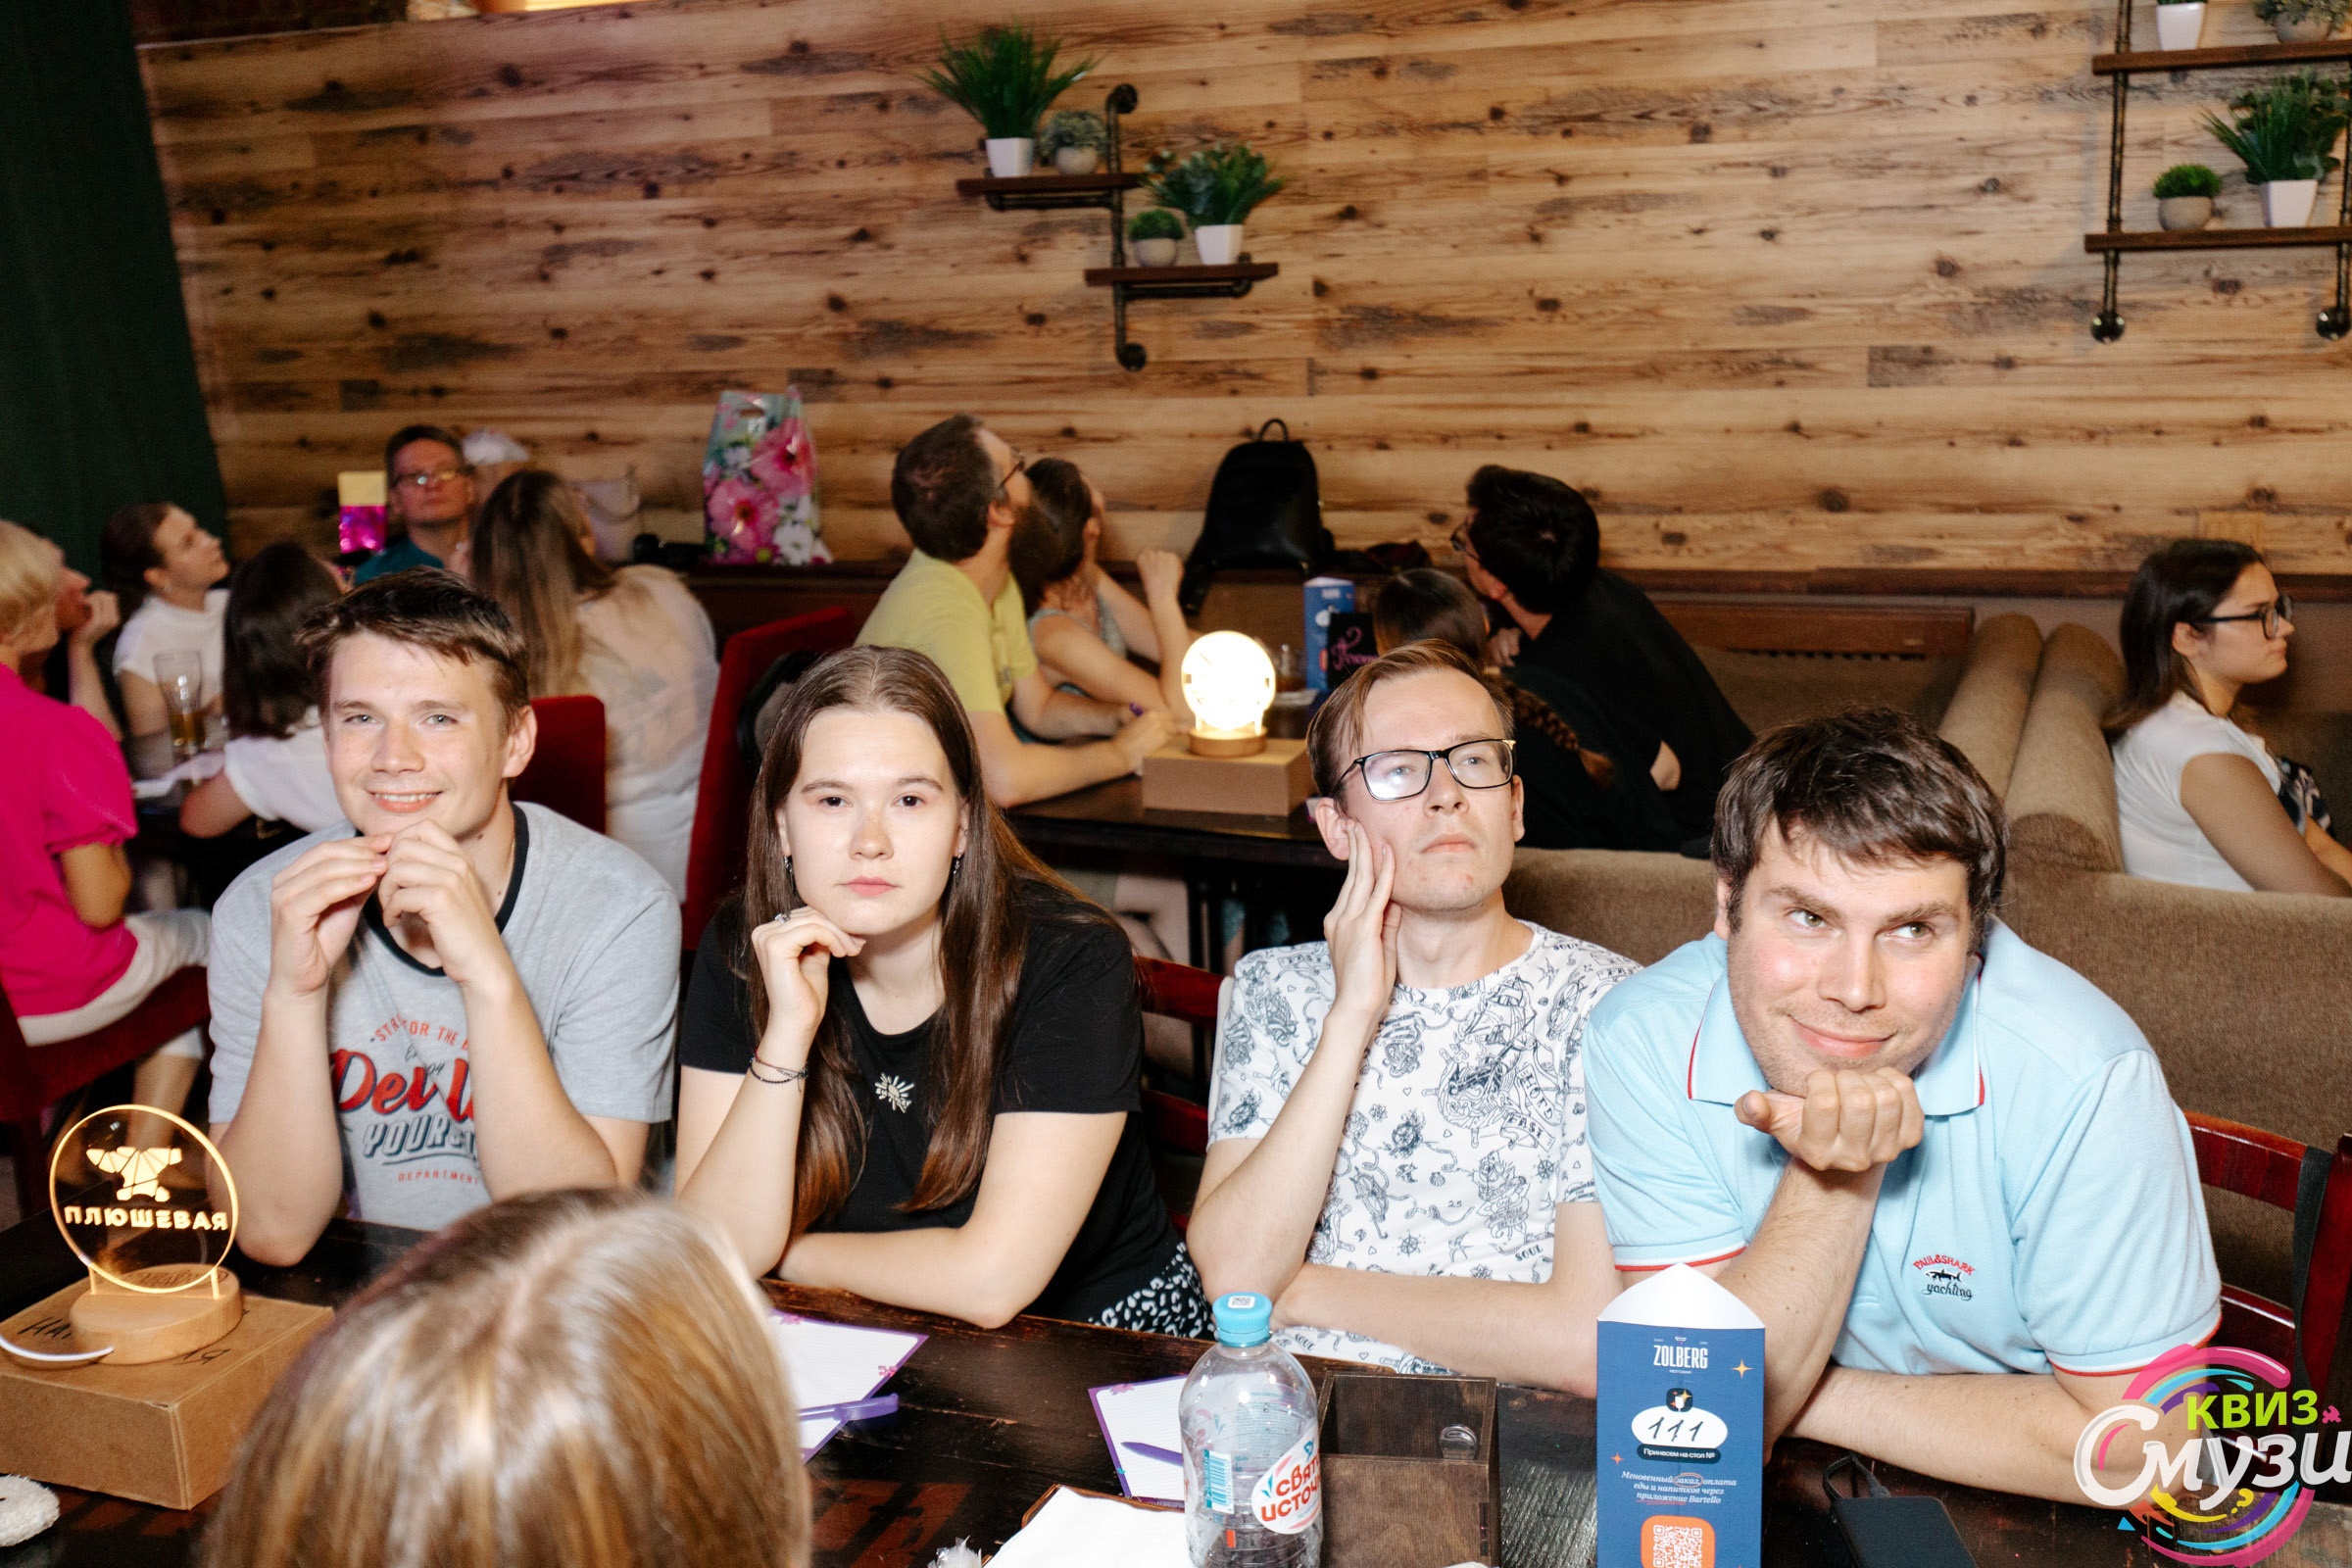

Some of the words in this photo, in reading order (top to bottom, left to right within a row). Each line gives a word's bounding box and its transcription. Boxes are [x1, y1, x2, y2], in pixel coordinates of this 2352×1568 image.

[437, 1026, 459, 1046] THE
[1447, 1200, 1463, 1208] 25
[64, 1205, 228, 1231] ПЛЮШЕВАЯ
[1515, 1245, 1544, 1262] SOUL
[1913, 1253, 1976, 1276] PAUL&SHARK
[1922, 1282, 1973, 1301] yachting
[1653, 1345, 1708, 1369] ZOLBERG
[1648, 1416, 1703, 1442] 111
[1621, 1471, 1673, 1484] Мгновенный
[1634, 1482, 1649, 1491] еды
[1657, 1485, 1700, 1494] напитков
[1701, 1488, 1724, 1496] через
[1636, 1492, 1688, 1502] приложение
[1689, 1494, 1722, 1504] Bartello
